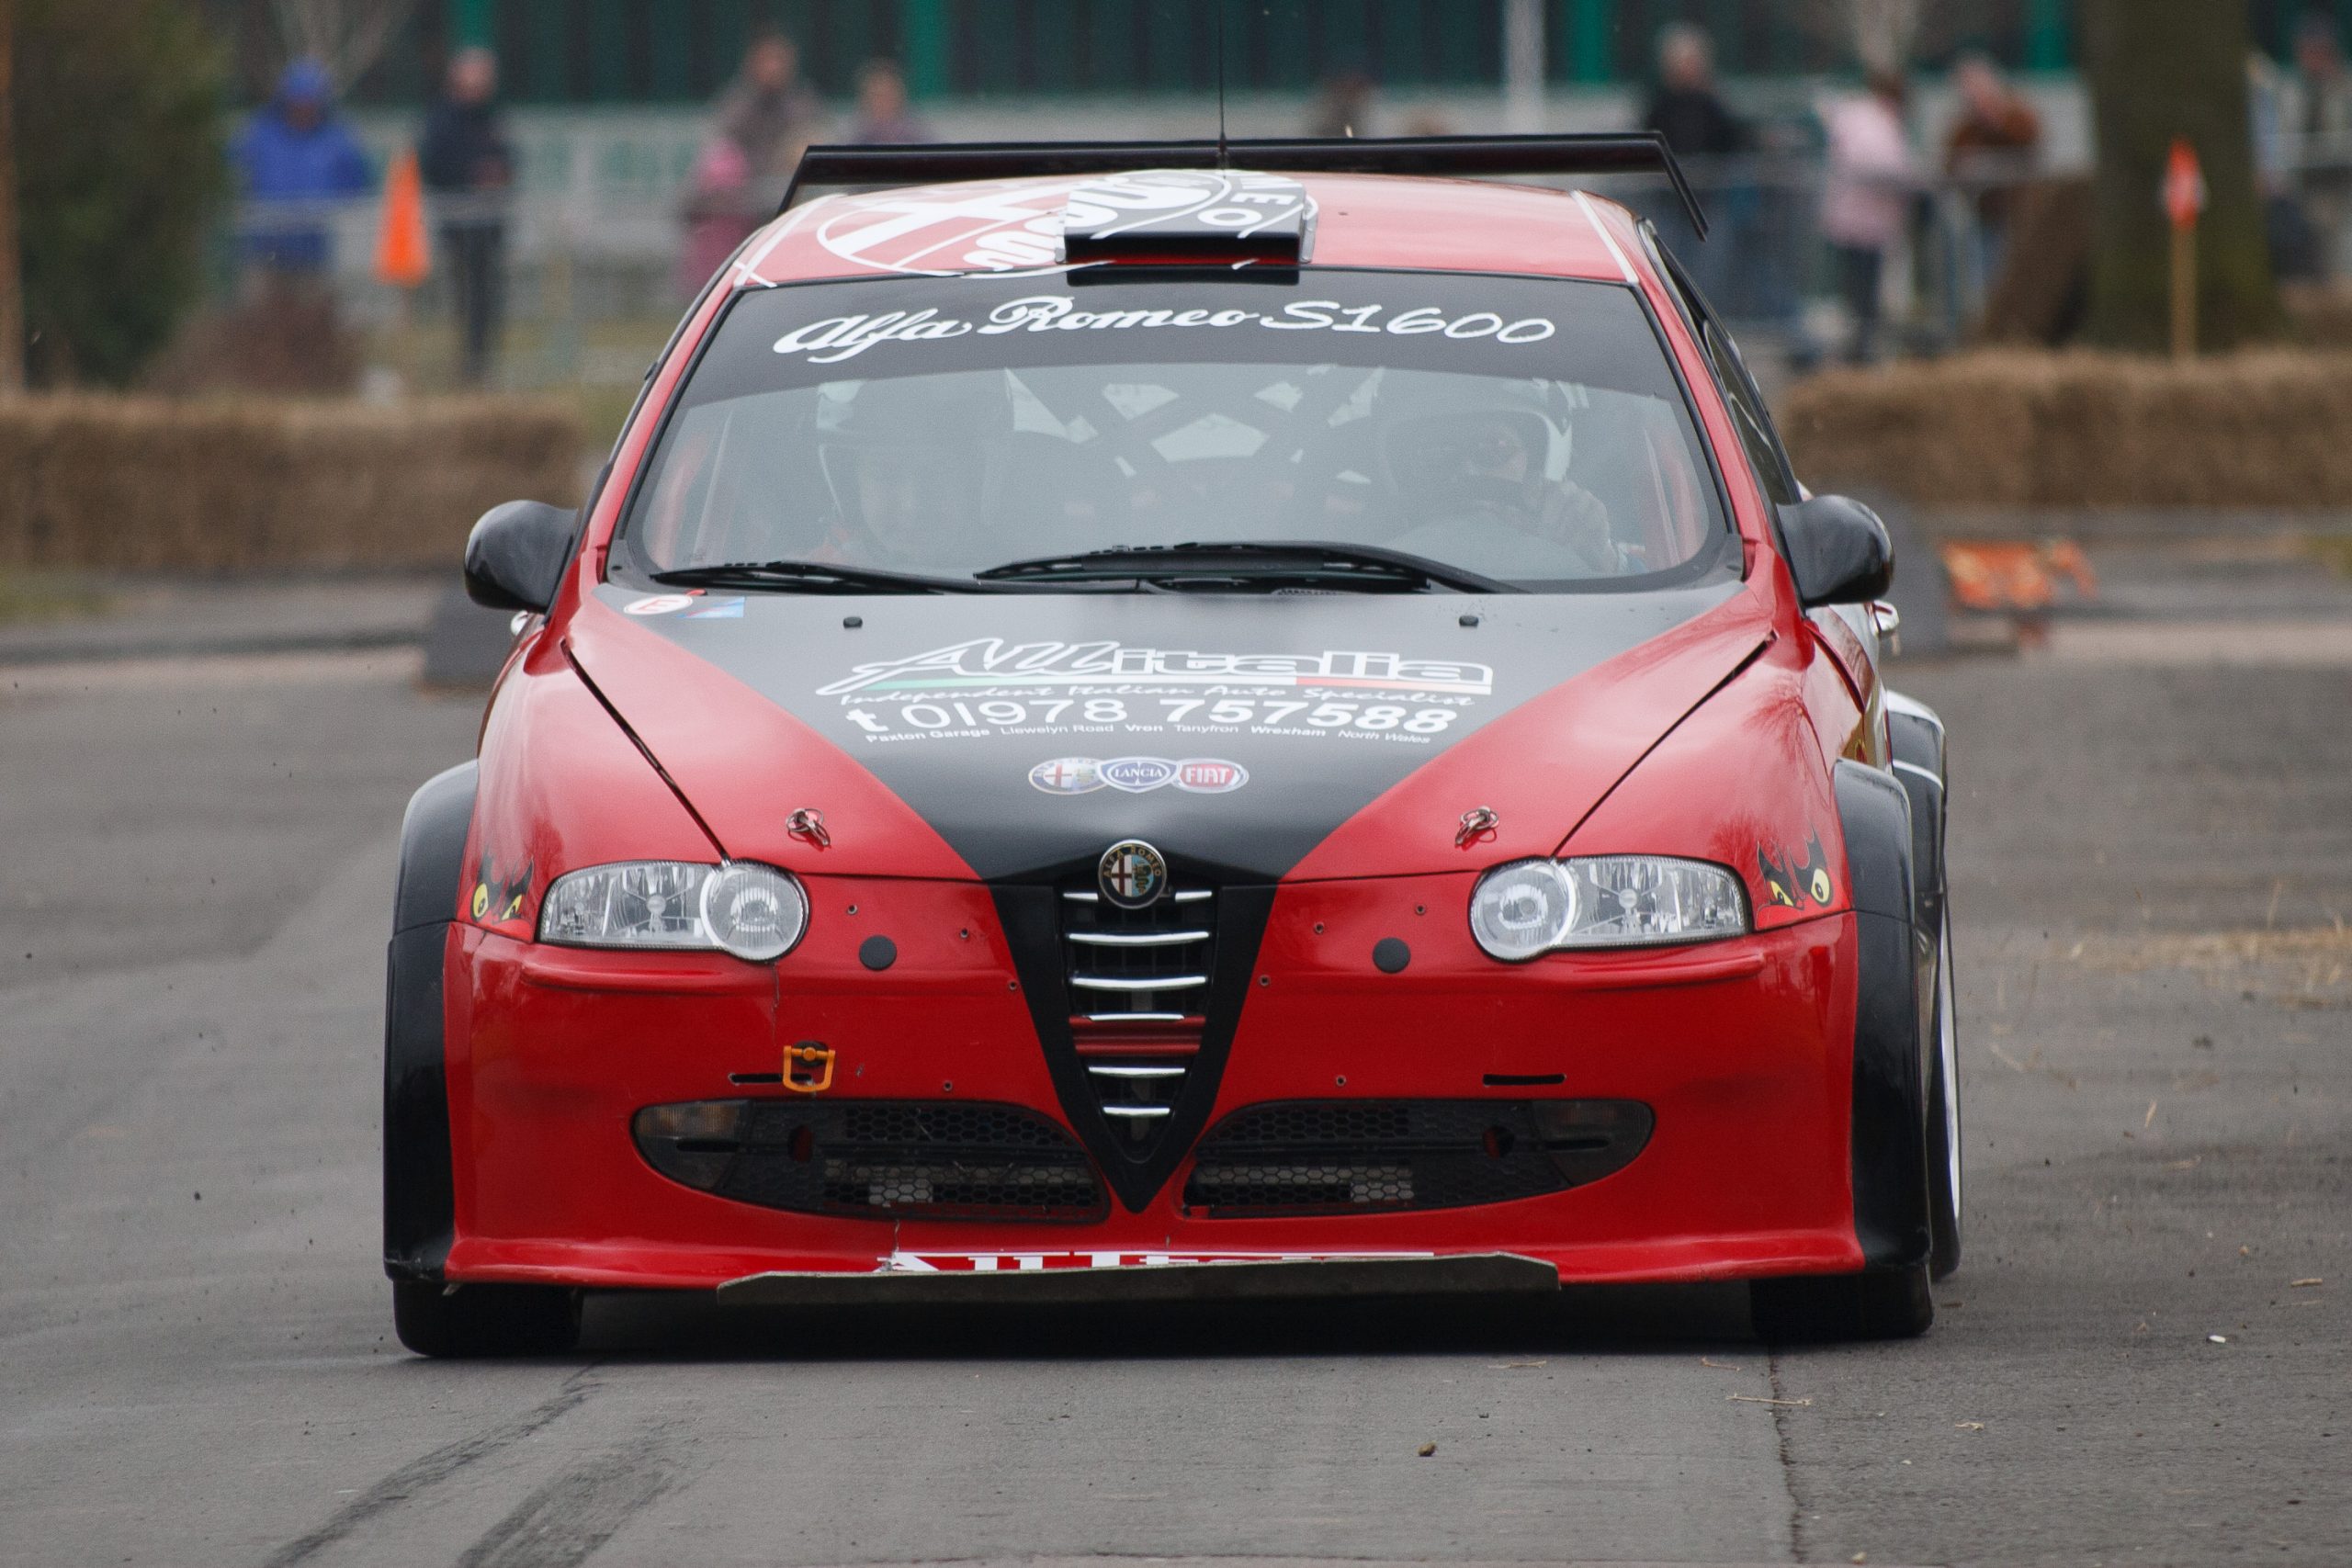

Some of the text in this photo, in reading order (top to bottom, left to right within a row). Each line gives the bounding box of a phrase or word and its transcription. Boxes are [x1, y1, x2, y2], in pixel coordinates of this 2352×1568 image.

[773, 296, 1555, 363] Alfa Romeo S1600
[841, 684, 1475, 706] Independent Italian Auto Specialist
[845, 698, 1457, 733] t 01978 757588
[865, 723, 1430, 744] Paxton Garage Llewelyn Road Vron Tanyfron Wrexham North Wales
[1114, 768, 1163, 778] LANCIA
[1185, 768, 1231, 784] FIAT
[1102, 845, 1162, 878] ALFA ROMEO
